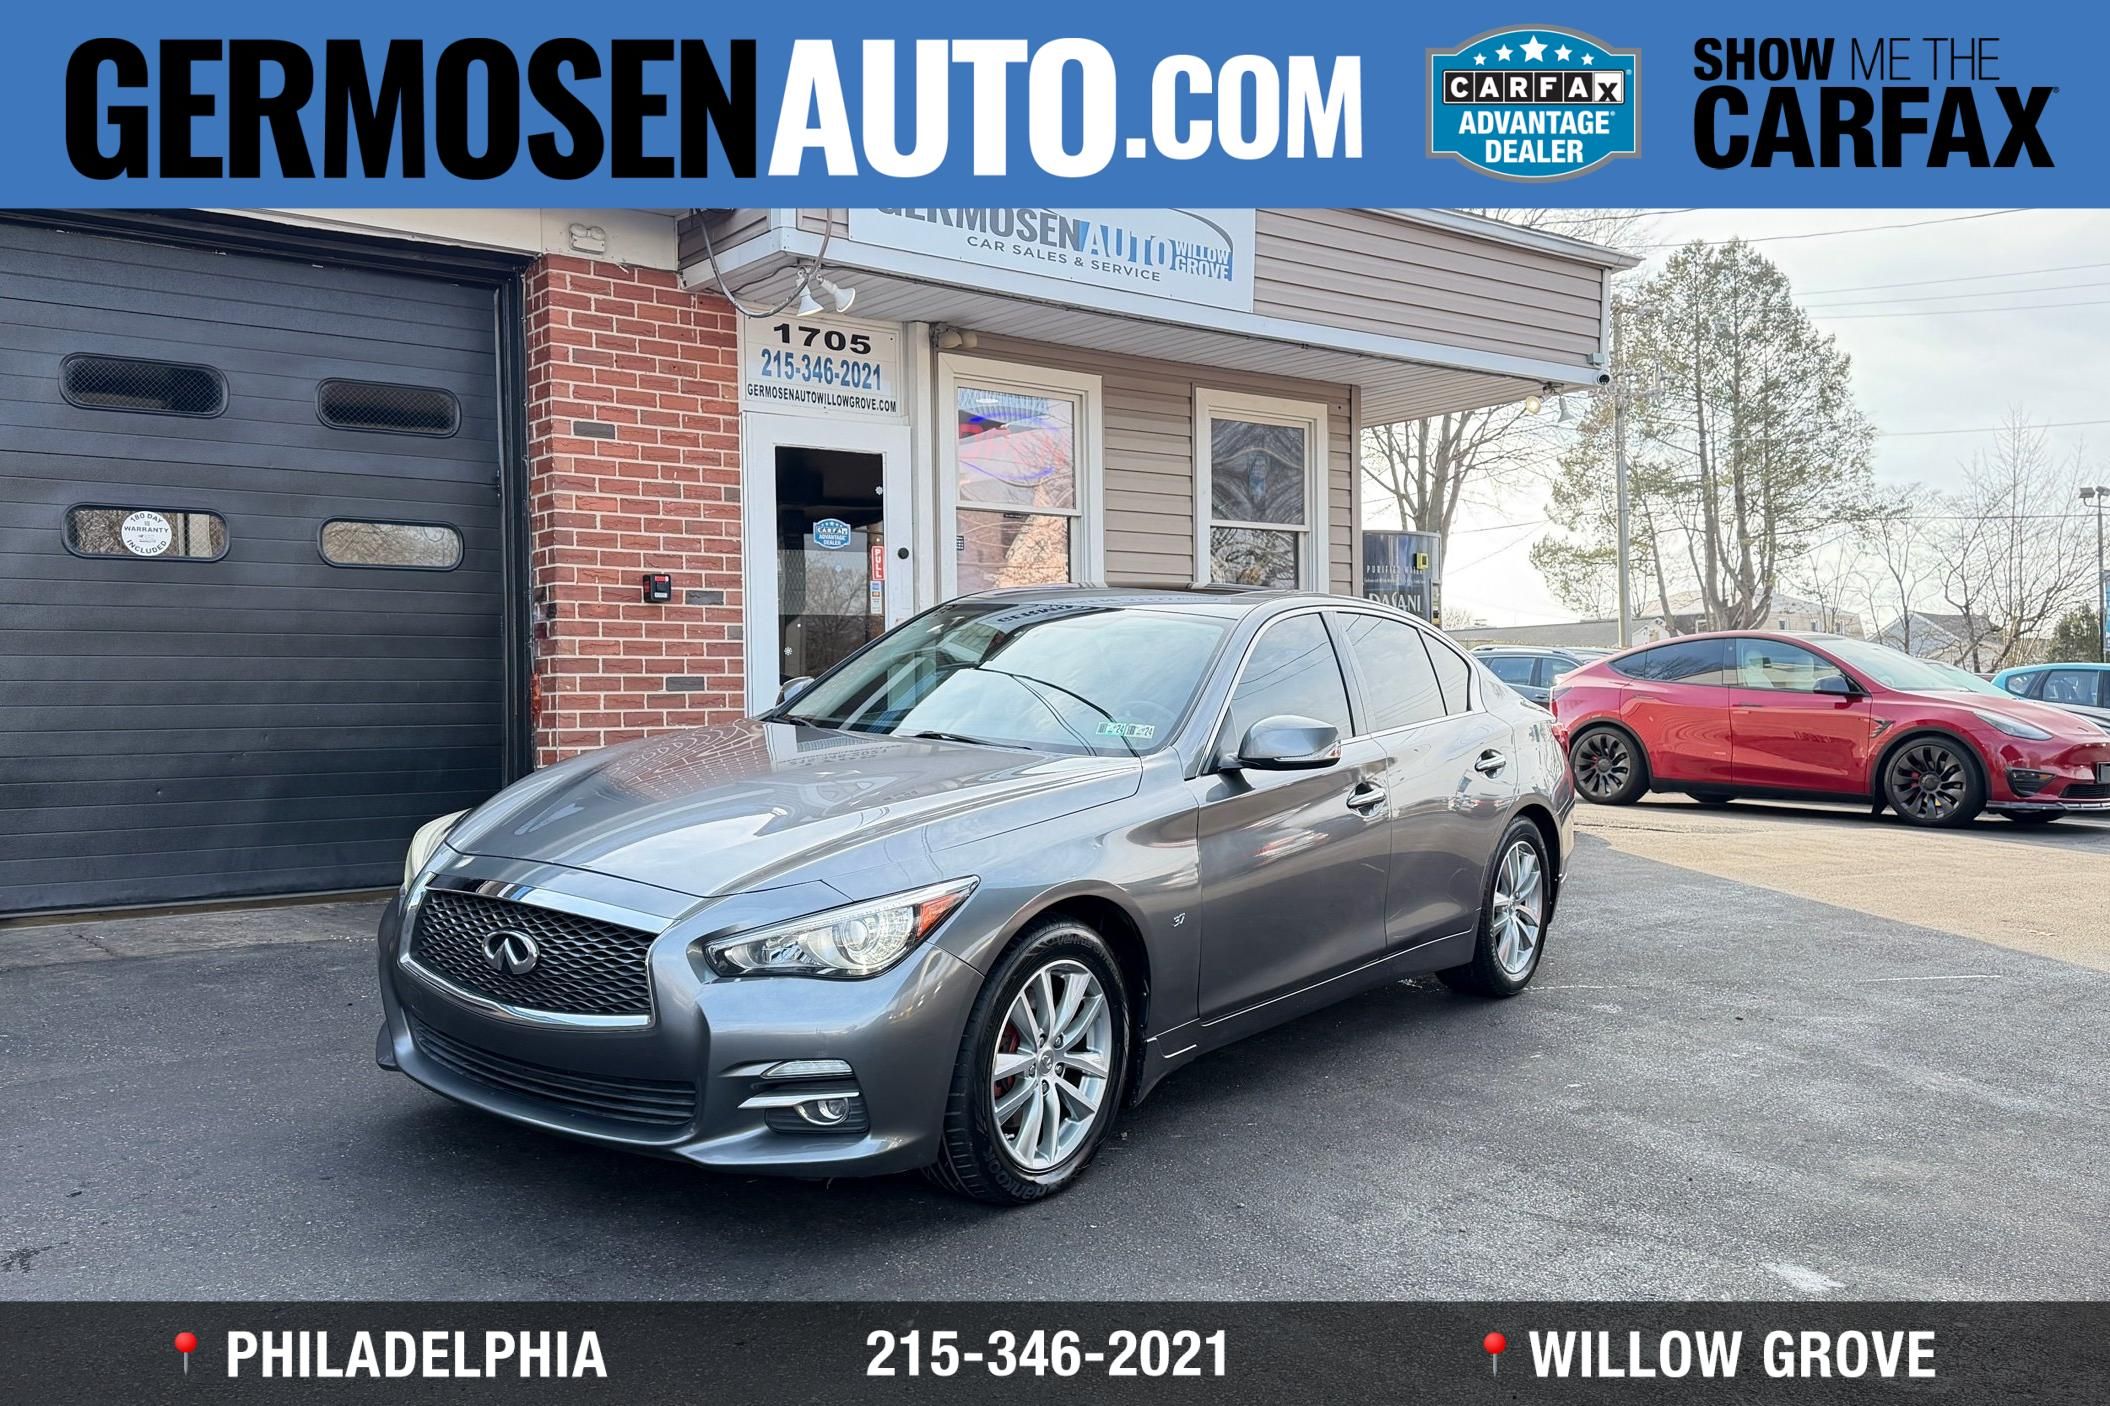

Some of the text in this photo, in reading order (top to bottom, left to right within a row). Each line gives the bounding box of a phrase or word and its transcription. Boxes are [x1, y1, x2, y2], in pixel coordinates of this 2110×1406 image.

[967, 236, 1161, 282] CAR SALES & SERVICE
[1175, 240, 1232, 265] WILLOW
[1174, 256, 1231, 281] GROVE
[773, 323, 872, 355] 1705
[761, 348, 881, 391] 215-346-2021
[747, 383, 897, 413] GERMOSENAUTOWILLOWGROVE.COM
[124, 525, 169, 533] WARRANTY
[127, 539, 167, 554] INCLUDED
